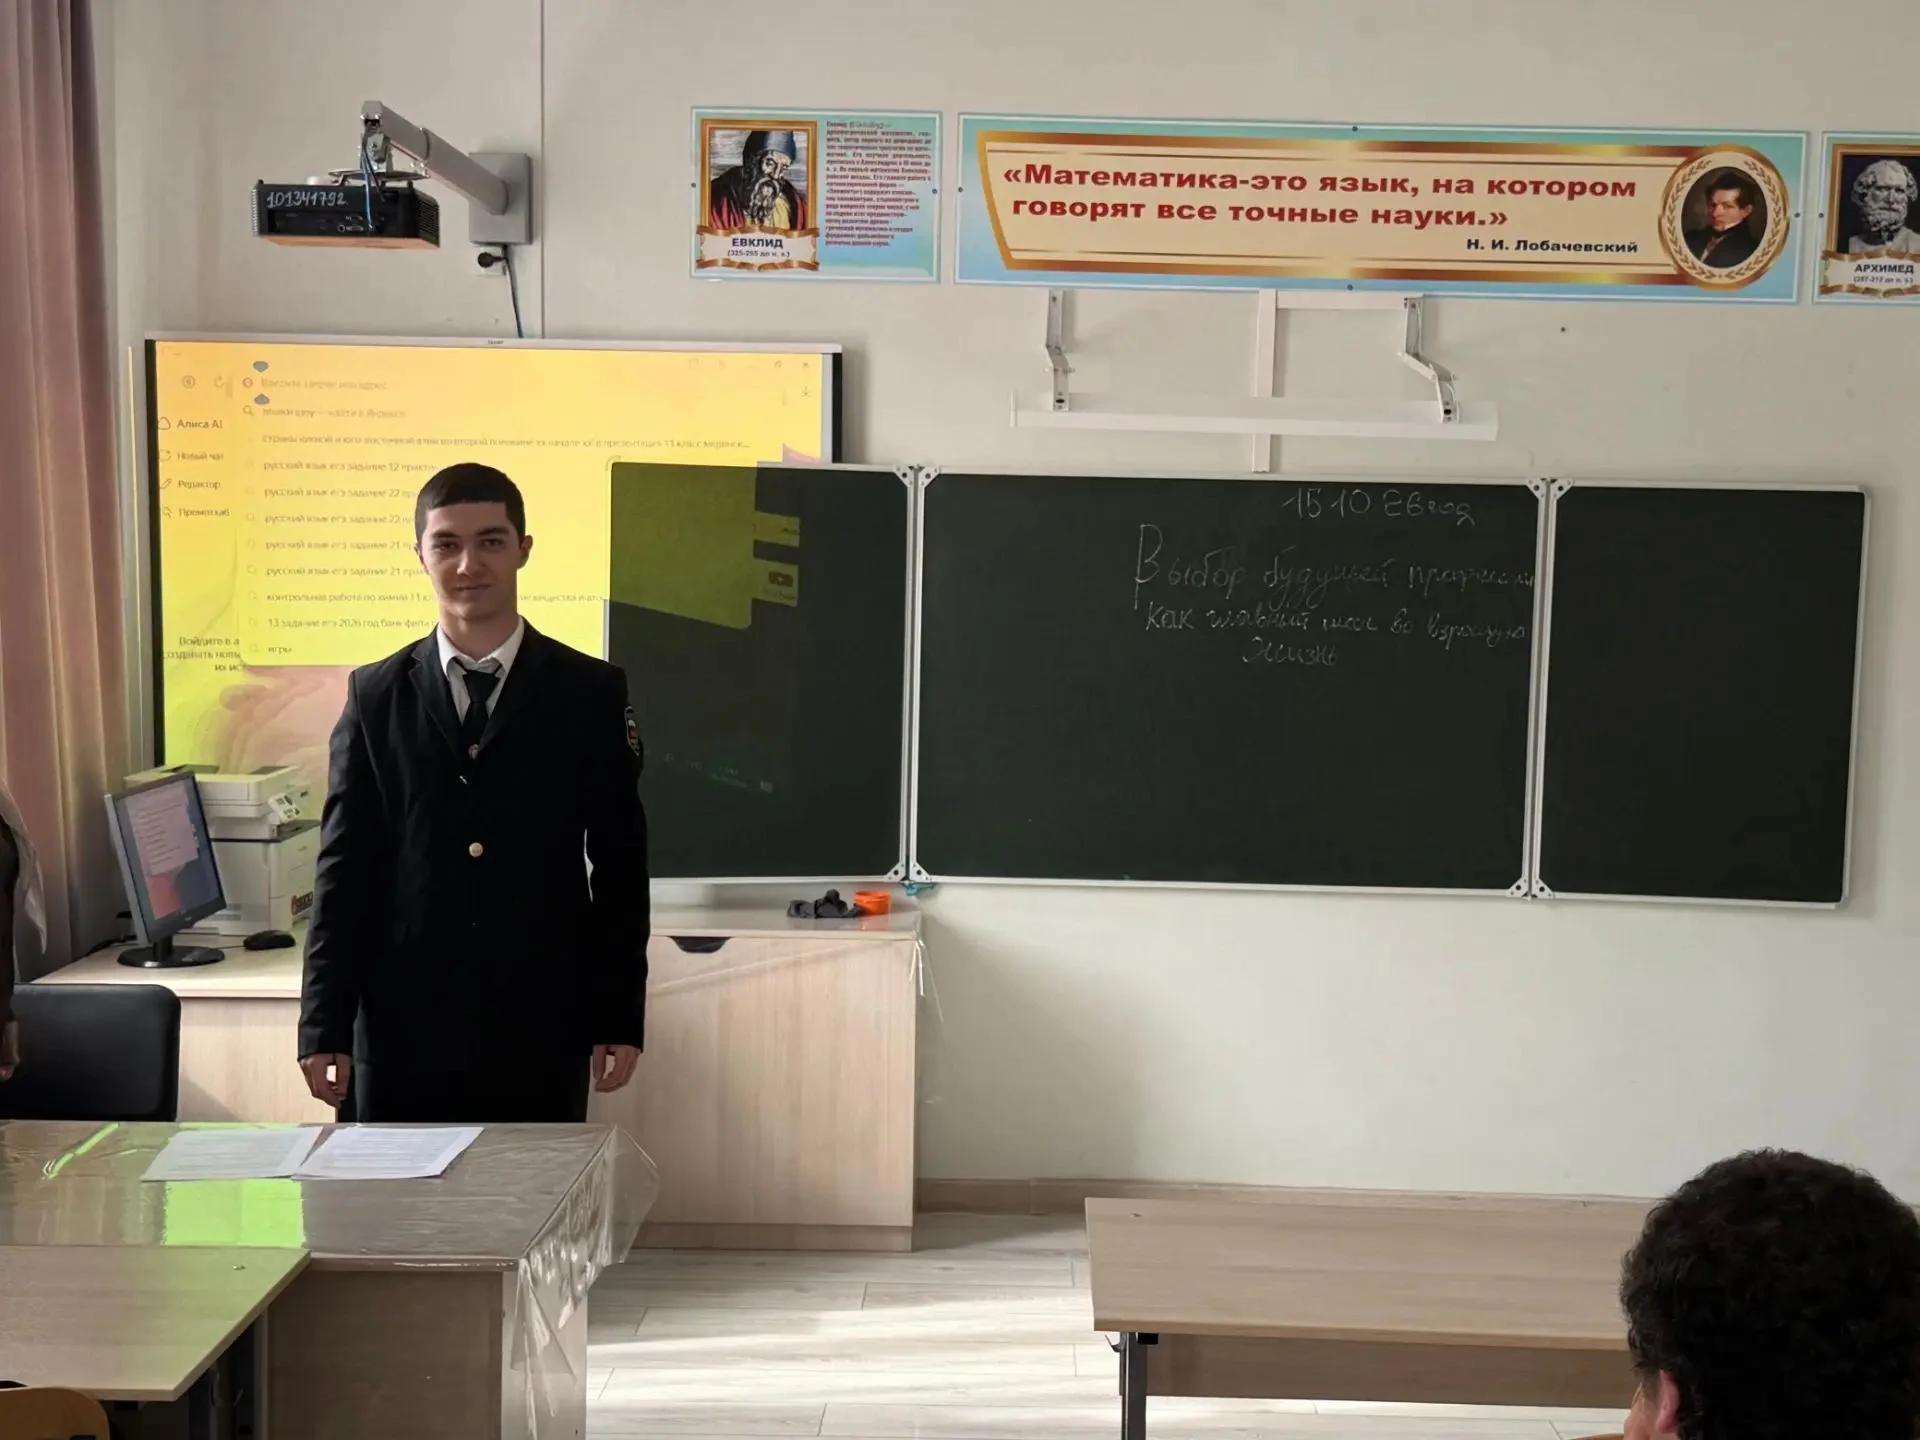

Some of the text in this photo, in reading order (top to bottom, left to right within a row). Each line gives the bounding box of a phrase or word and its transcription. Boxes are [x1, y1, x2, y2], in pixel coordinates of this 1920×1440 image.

[1004, 163, 1636, 201] «Математика-это язык, на котором
[266, 191, 348, 208] 101341792
[1012, 200, 1508, 230] говорят все точные науки.»
[731, 238, 784, 249] ЕВКЛИД
[1467, 239, 1638, 253] Н. И. Лобачевский
[1854, 264, 1914, 274] АРХИМЕД
[177, 418, 209, 428] Алиса
[178, 479, 222, 490] Редактор
[1134, 524, 1246, 610] Выбор
